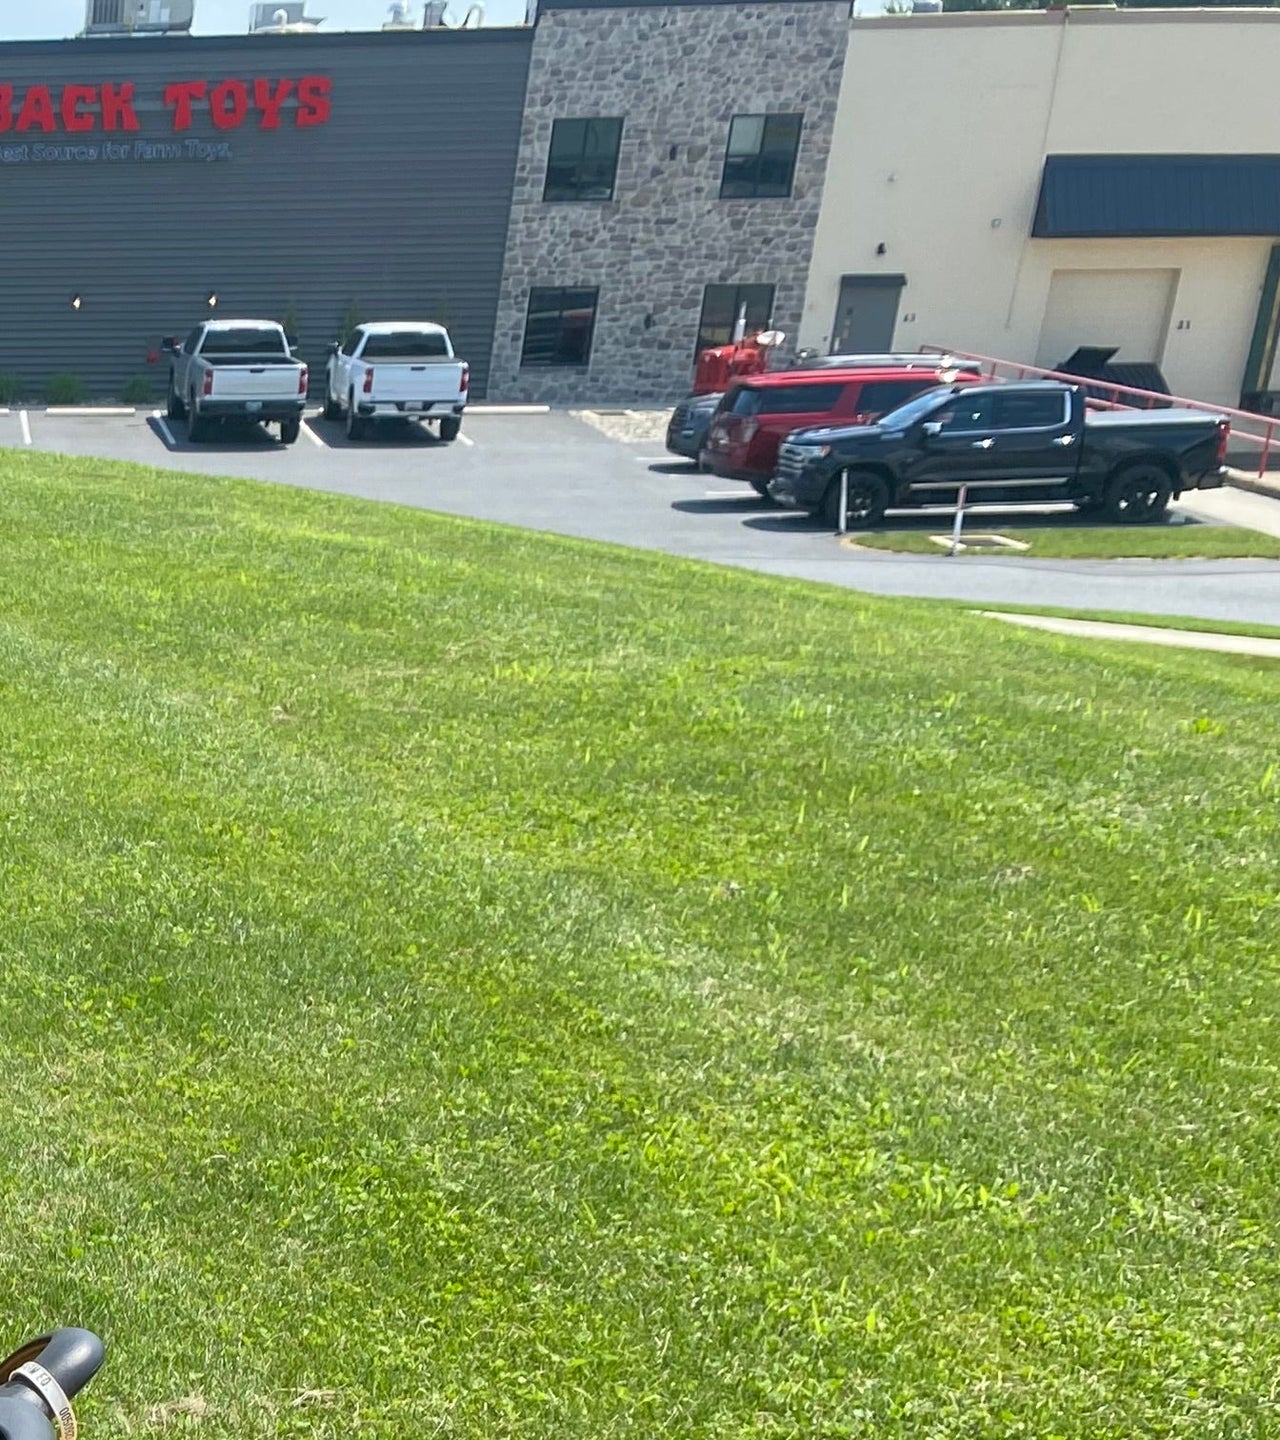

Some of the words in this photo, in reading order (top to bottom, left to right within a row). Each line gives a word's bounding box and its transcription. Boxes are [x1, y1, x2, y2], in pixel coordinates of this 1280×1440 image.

[163, 76, 332, 132] TOYS
[32, 142, 99, 161] Source
[102, 141, 130, 160] for
[134, 140, 181, 160] Farm
